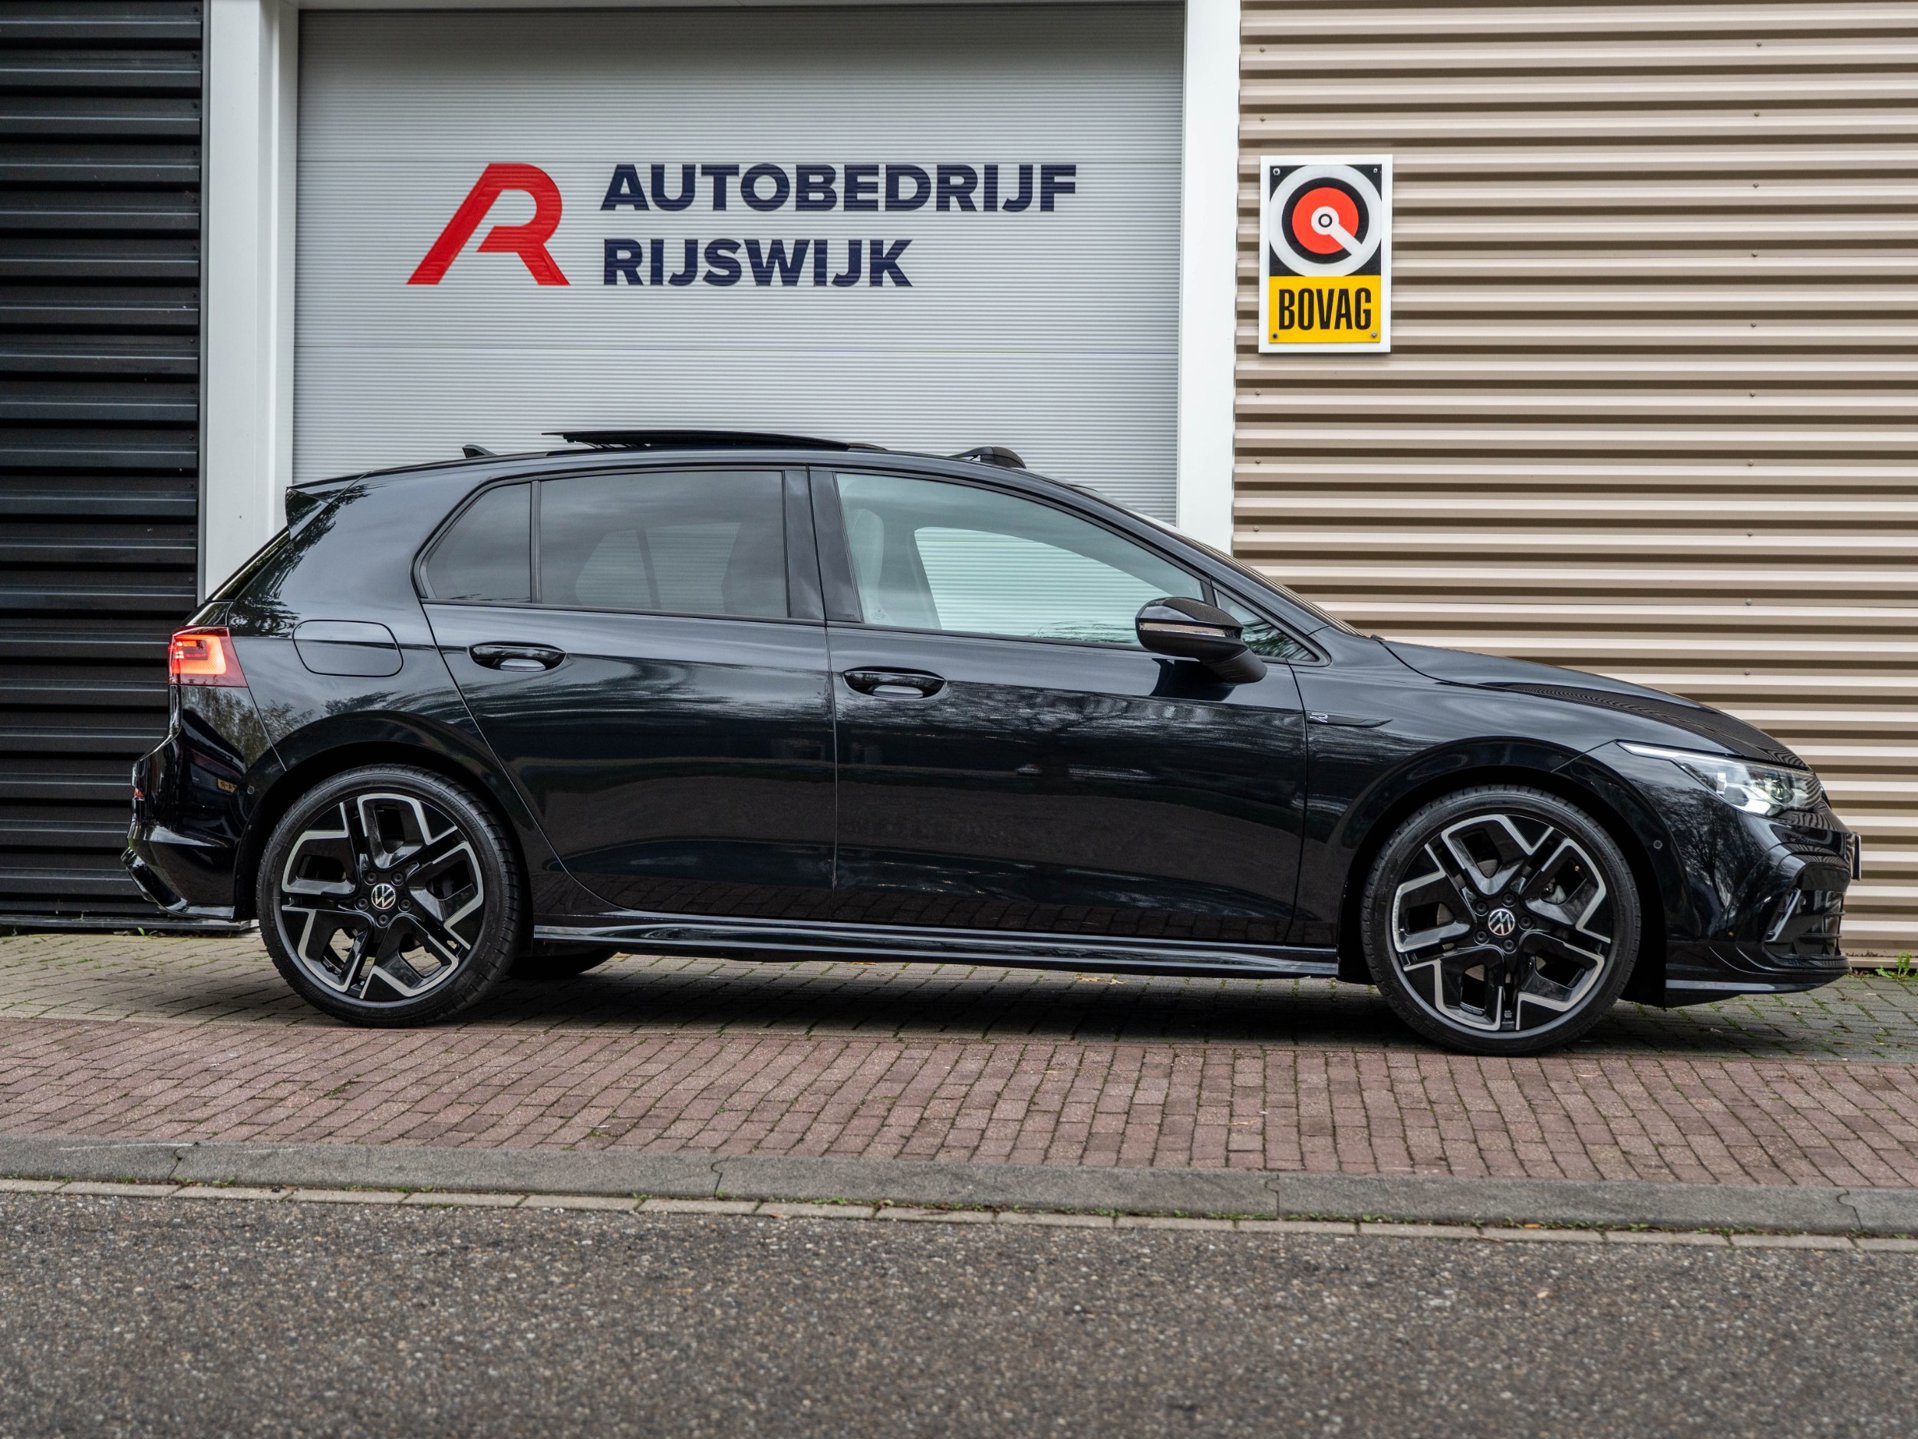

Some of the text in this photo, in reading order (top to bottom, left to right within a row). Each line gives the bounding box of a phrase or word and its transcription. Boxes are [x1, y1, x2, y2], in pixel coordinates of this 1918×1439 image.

[600, 163, 1076, 212] AUTOBEDRIJF
[603, 239, 913, 287] RIJSWIJK
[1278, 287, 1372, 331] BOVAG
